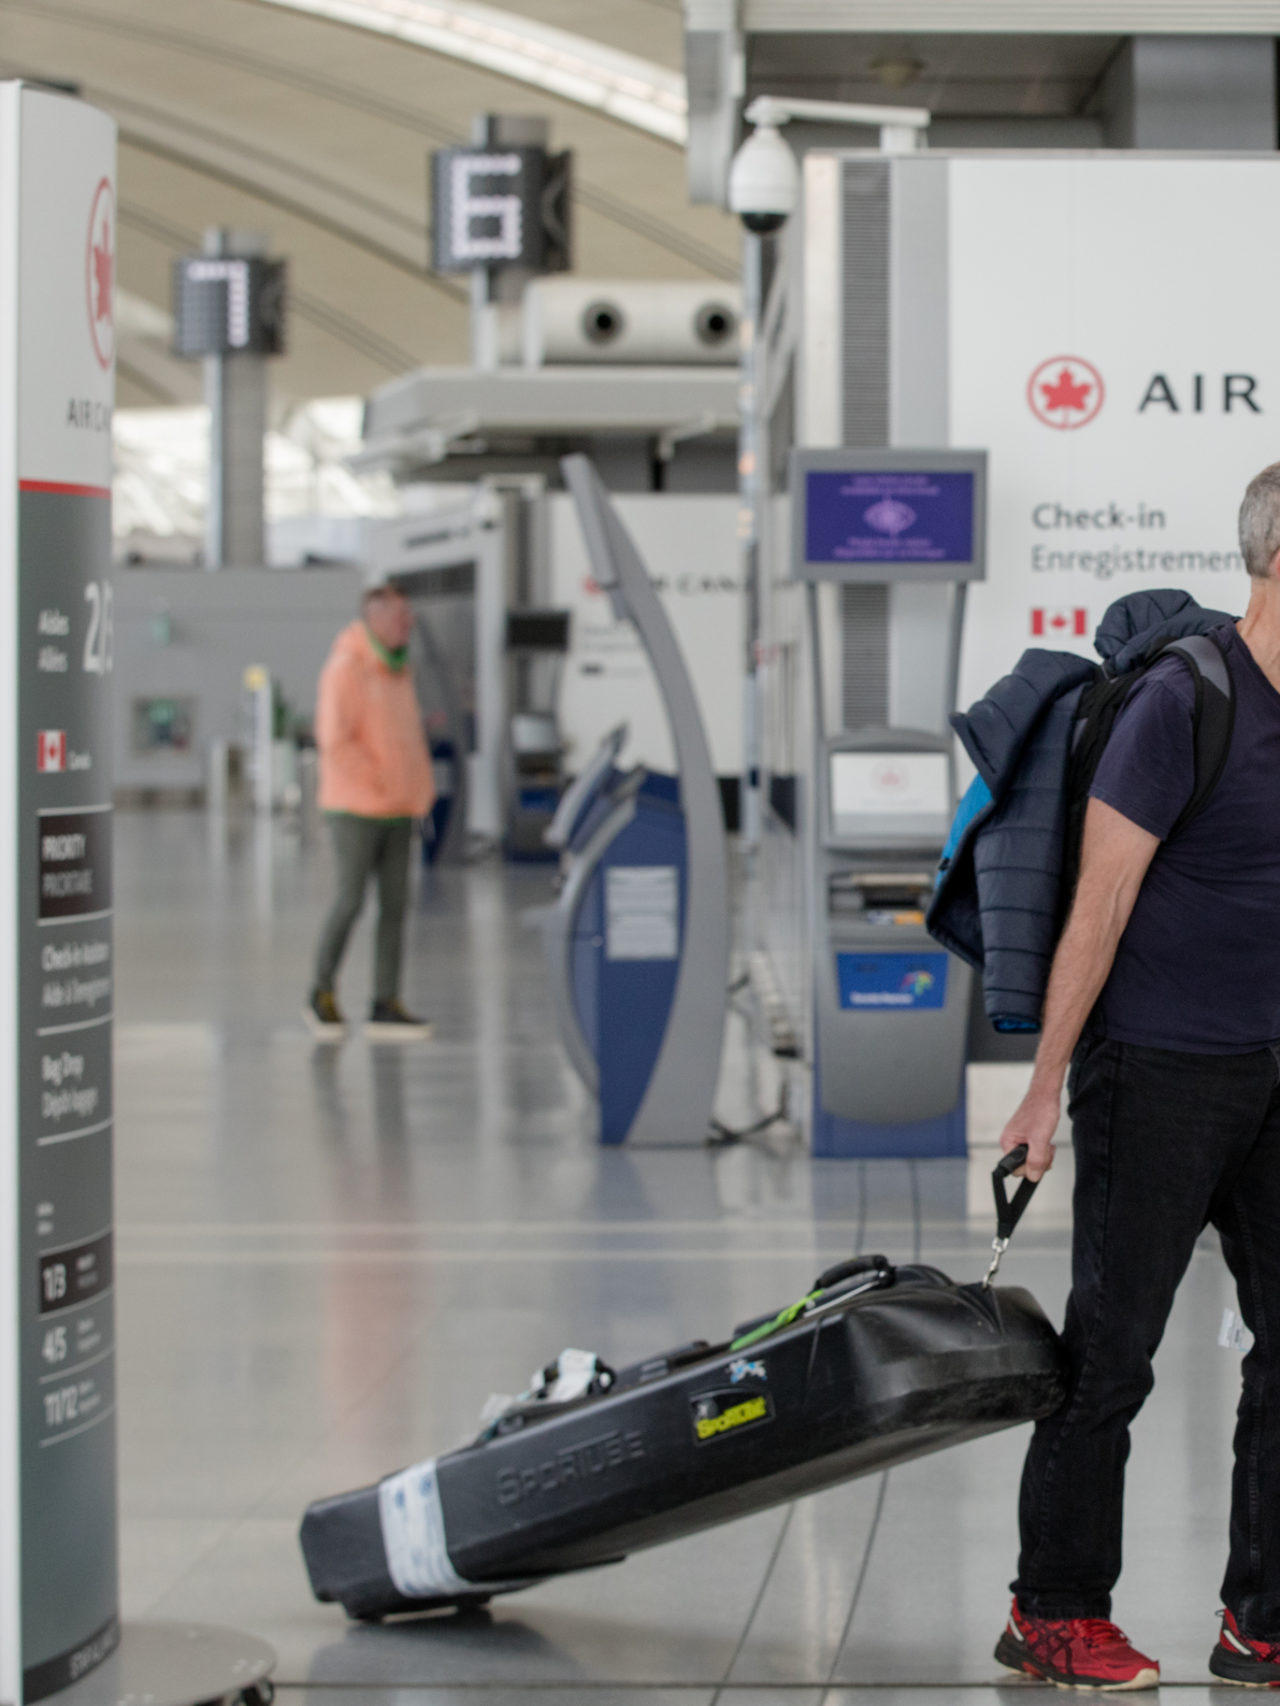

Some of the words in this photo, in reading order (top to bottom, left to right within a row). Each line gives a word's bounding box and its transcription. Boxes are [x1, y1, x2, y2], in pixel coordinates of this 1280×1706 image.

[450, 153, 522, 258] 6
[186, 260, 249, 347] 7
[1137, 373, 1262, 415] AIR
[1032, 502, 1166, 531] Check-in
[1031, 544, 1242, 579] Enregistremen
